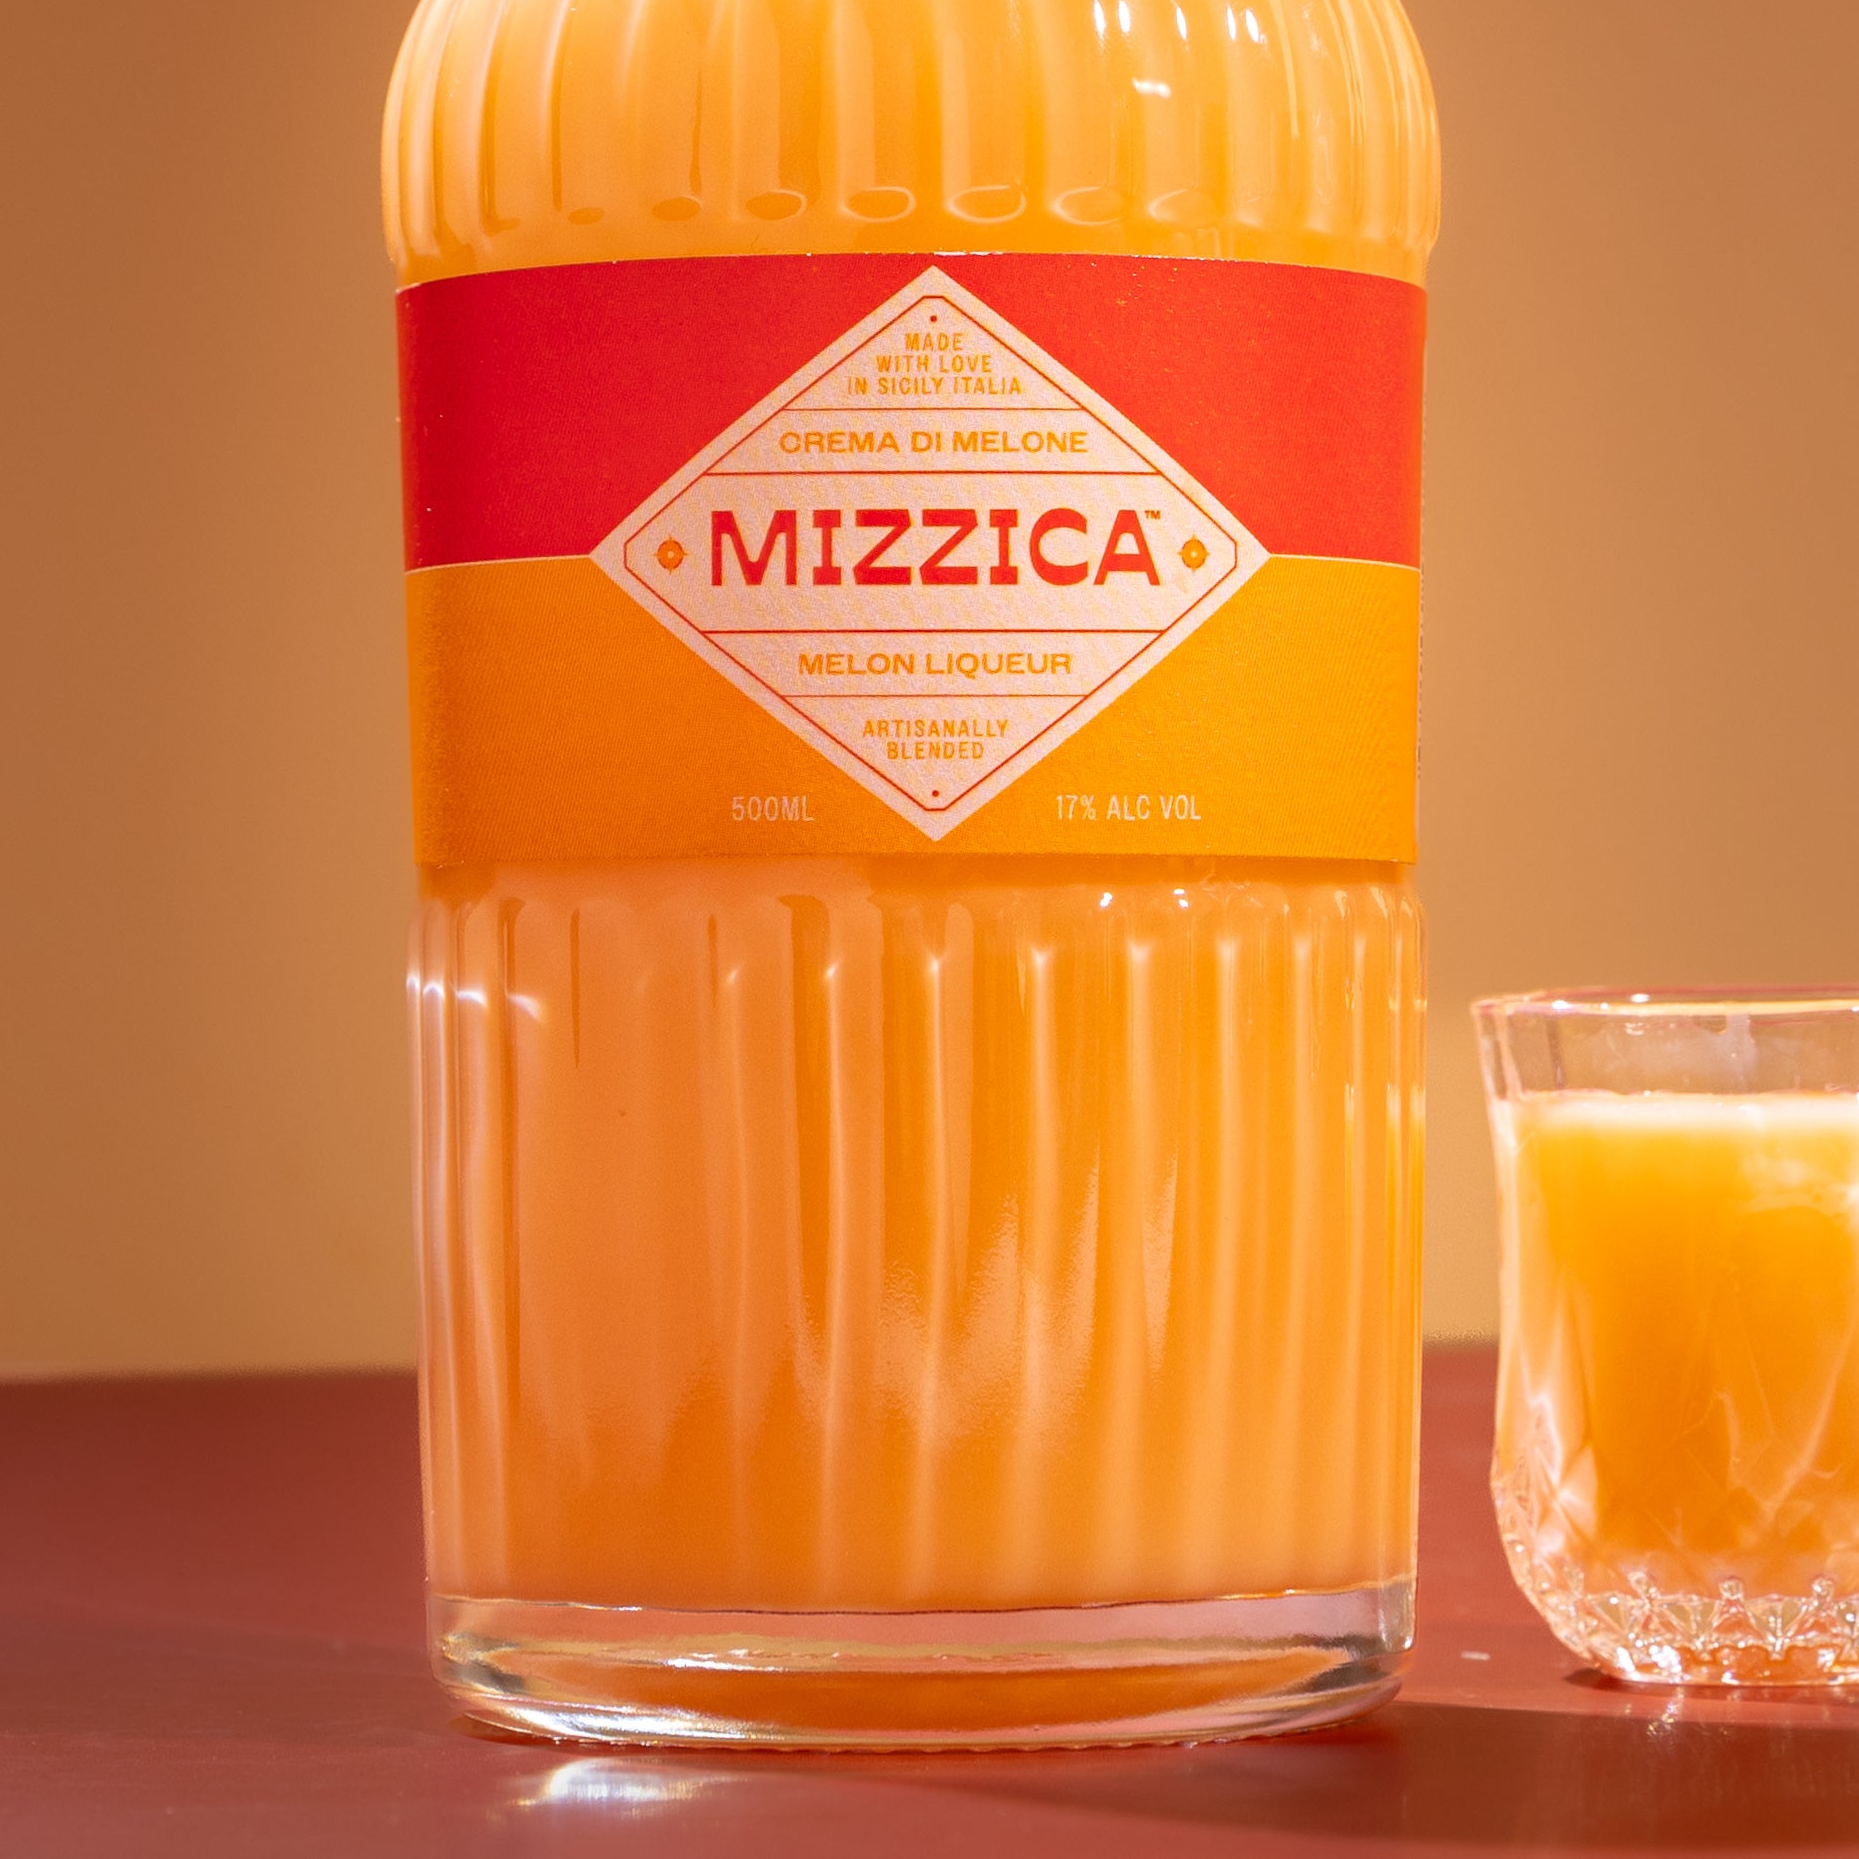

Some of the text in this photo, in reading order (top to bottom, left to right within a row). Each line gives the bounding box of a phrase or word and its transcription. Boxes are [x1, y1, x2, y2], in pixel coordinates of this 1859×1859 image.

[905, 333, 963, 353] MADE
[875, 355, 993, 374] WITH LOVE
[847, 376, 1022, 396] IN SICILY ITALIA
[779, 431, 1088, 454] CREMA DI MELONE
[797, 652, 1072, 677] MELON LIQUEUR
[862, 719, 1009, 738] ARTISANALLY
[886, 742, 984, 760] BLENDED
[731, 796, 814, 822] 500ML
[1056, 795, 1202, 820] 17% ALC VOL
